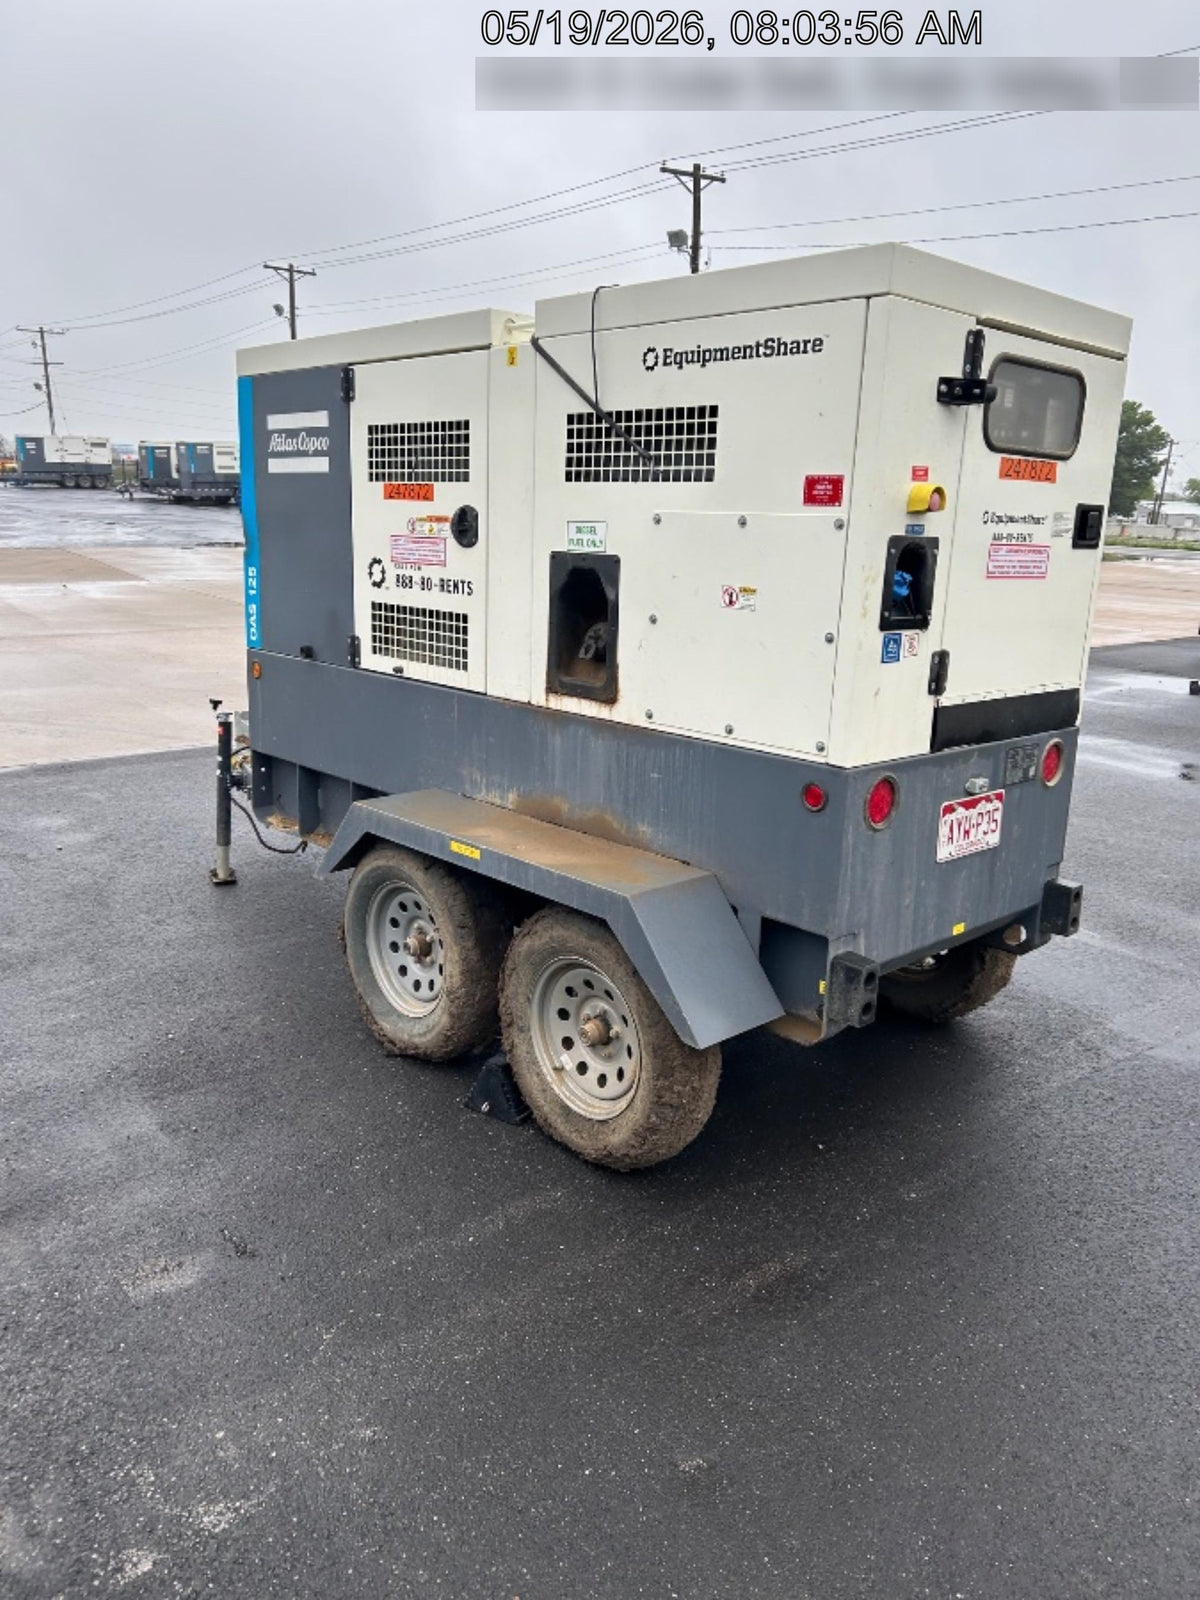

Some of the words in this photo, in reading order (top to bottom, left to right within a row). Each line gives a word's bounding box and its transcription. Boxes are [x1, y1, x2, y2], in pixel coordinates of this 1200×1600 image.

[662, 336, 825, 370] EquipmentShare
[268, 433, 297, 453] Atlas
[298, 431, 330, 455] Copco
[1003, 458, 1053, 481] 247872
[388, 483, 430, 500] 247872
[247, 566, 257, 596] 125
